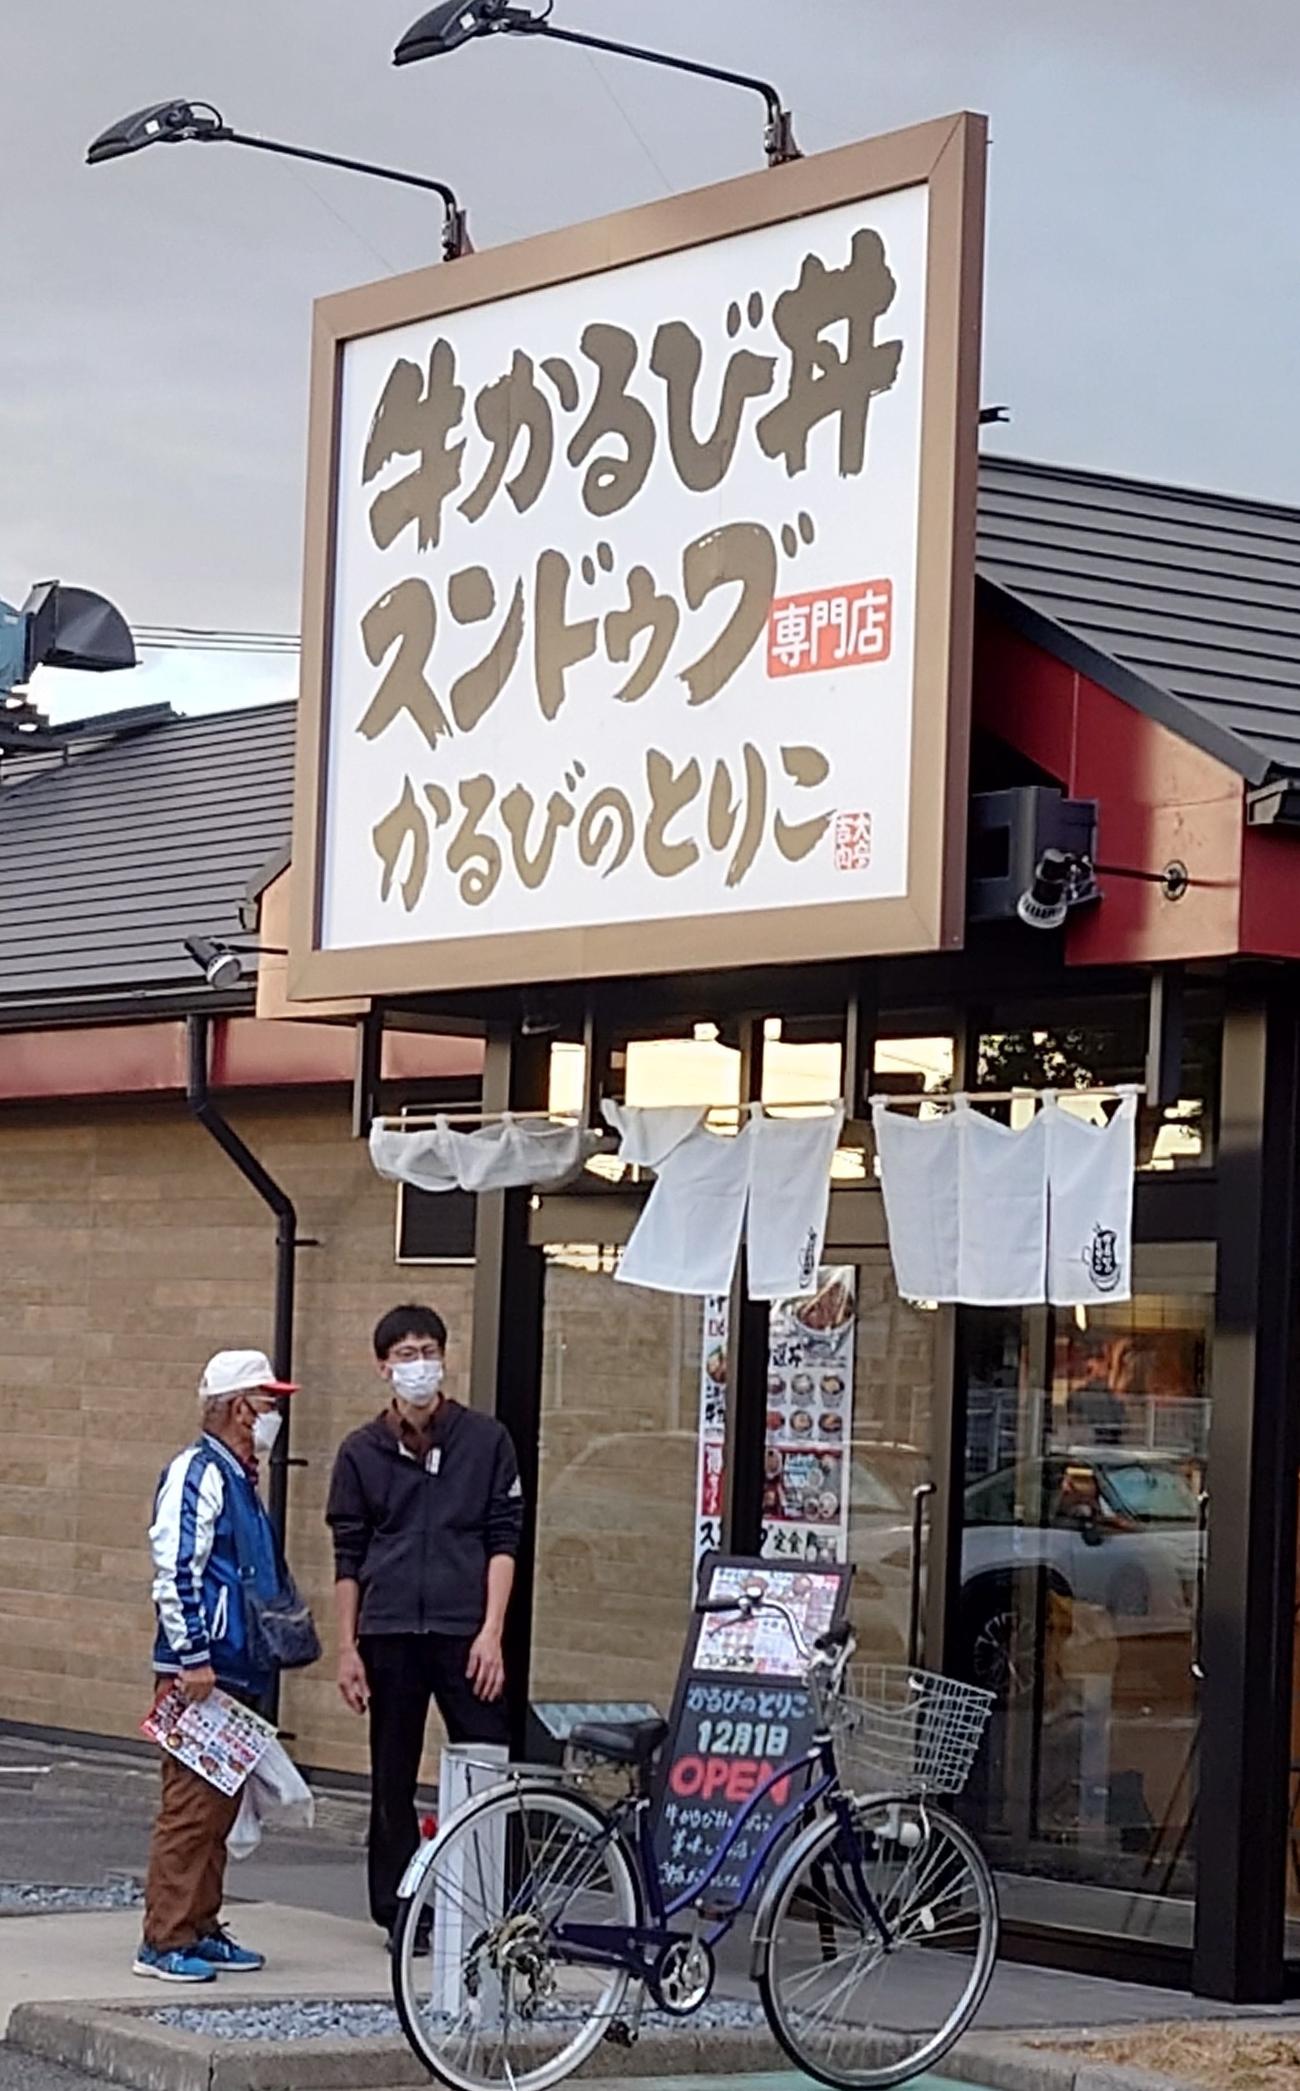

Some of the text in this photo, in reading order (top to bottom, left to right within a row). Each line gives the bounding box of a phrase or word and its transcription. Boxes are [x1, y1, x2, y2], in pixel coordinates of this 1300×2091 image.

[360, 227, 905, 554] 牛かるび丼
[355, 511, 815, 751] スンドゥブ
[771, 588, 889, 668] 専門店
[372, 742, 837, 913] かるびのとりこ
[669, 1755, 792, 1806] OPEN
[697, 1719, 789, 1757] 12月1日
